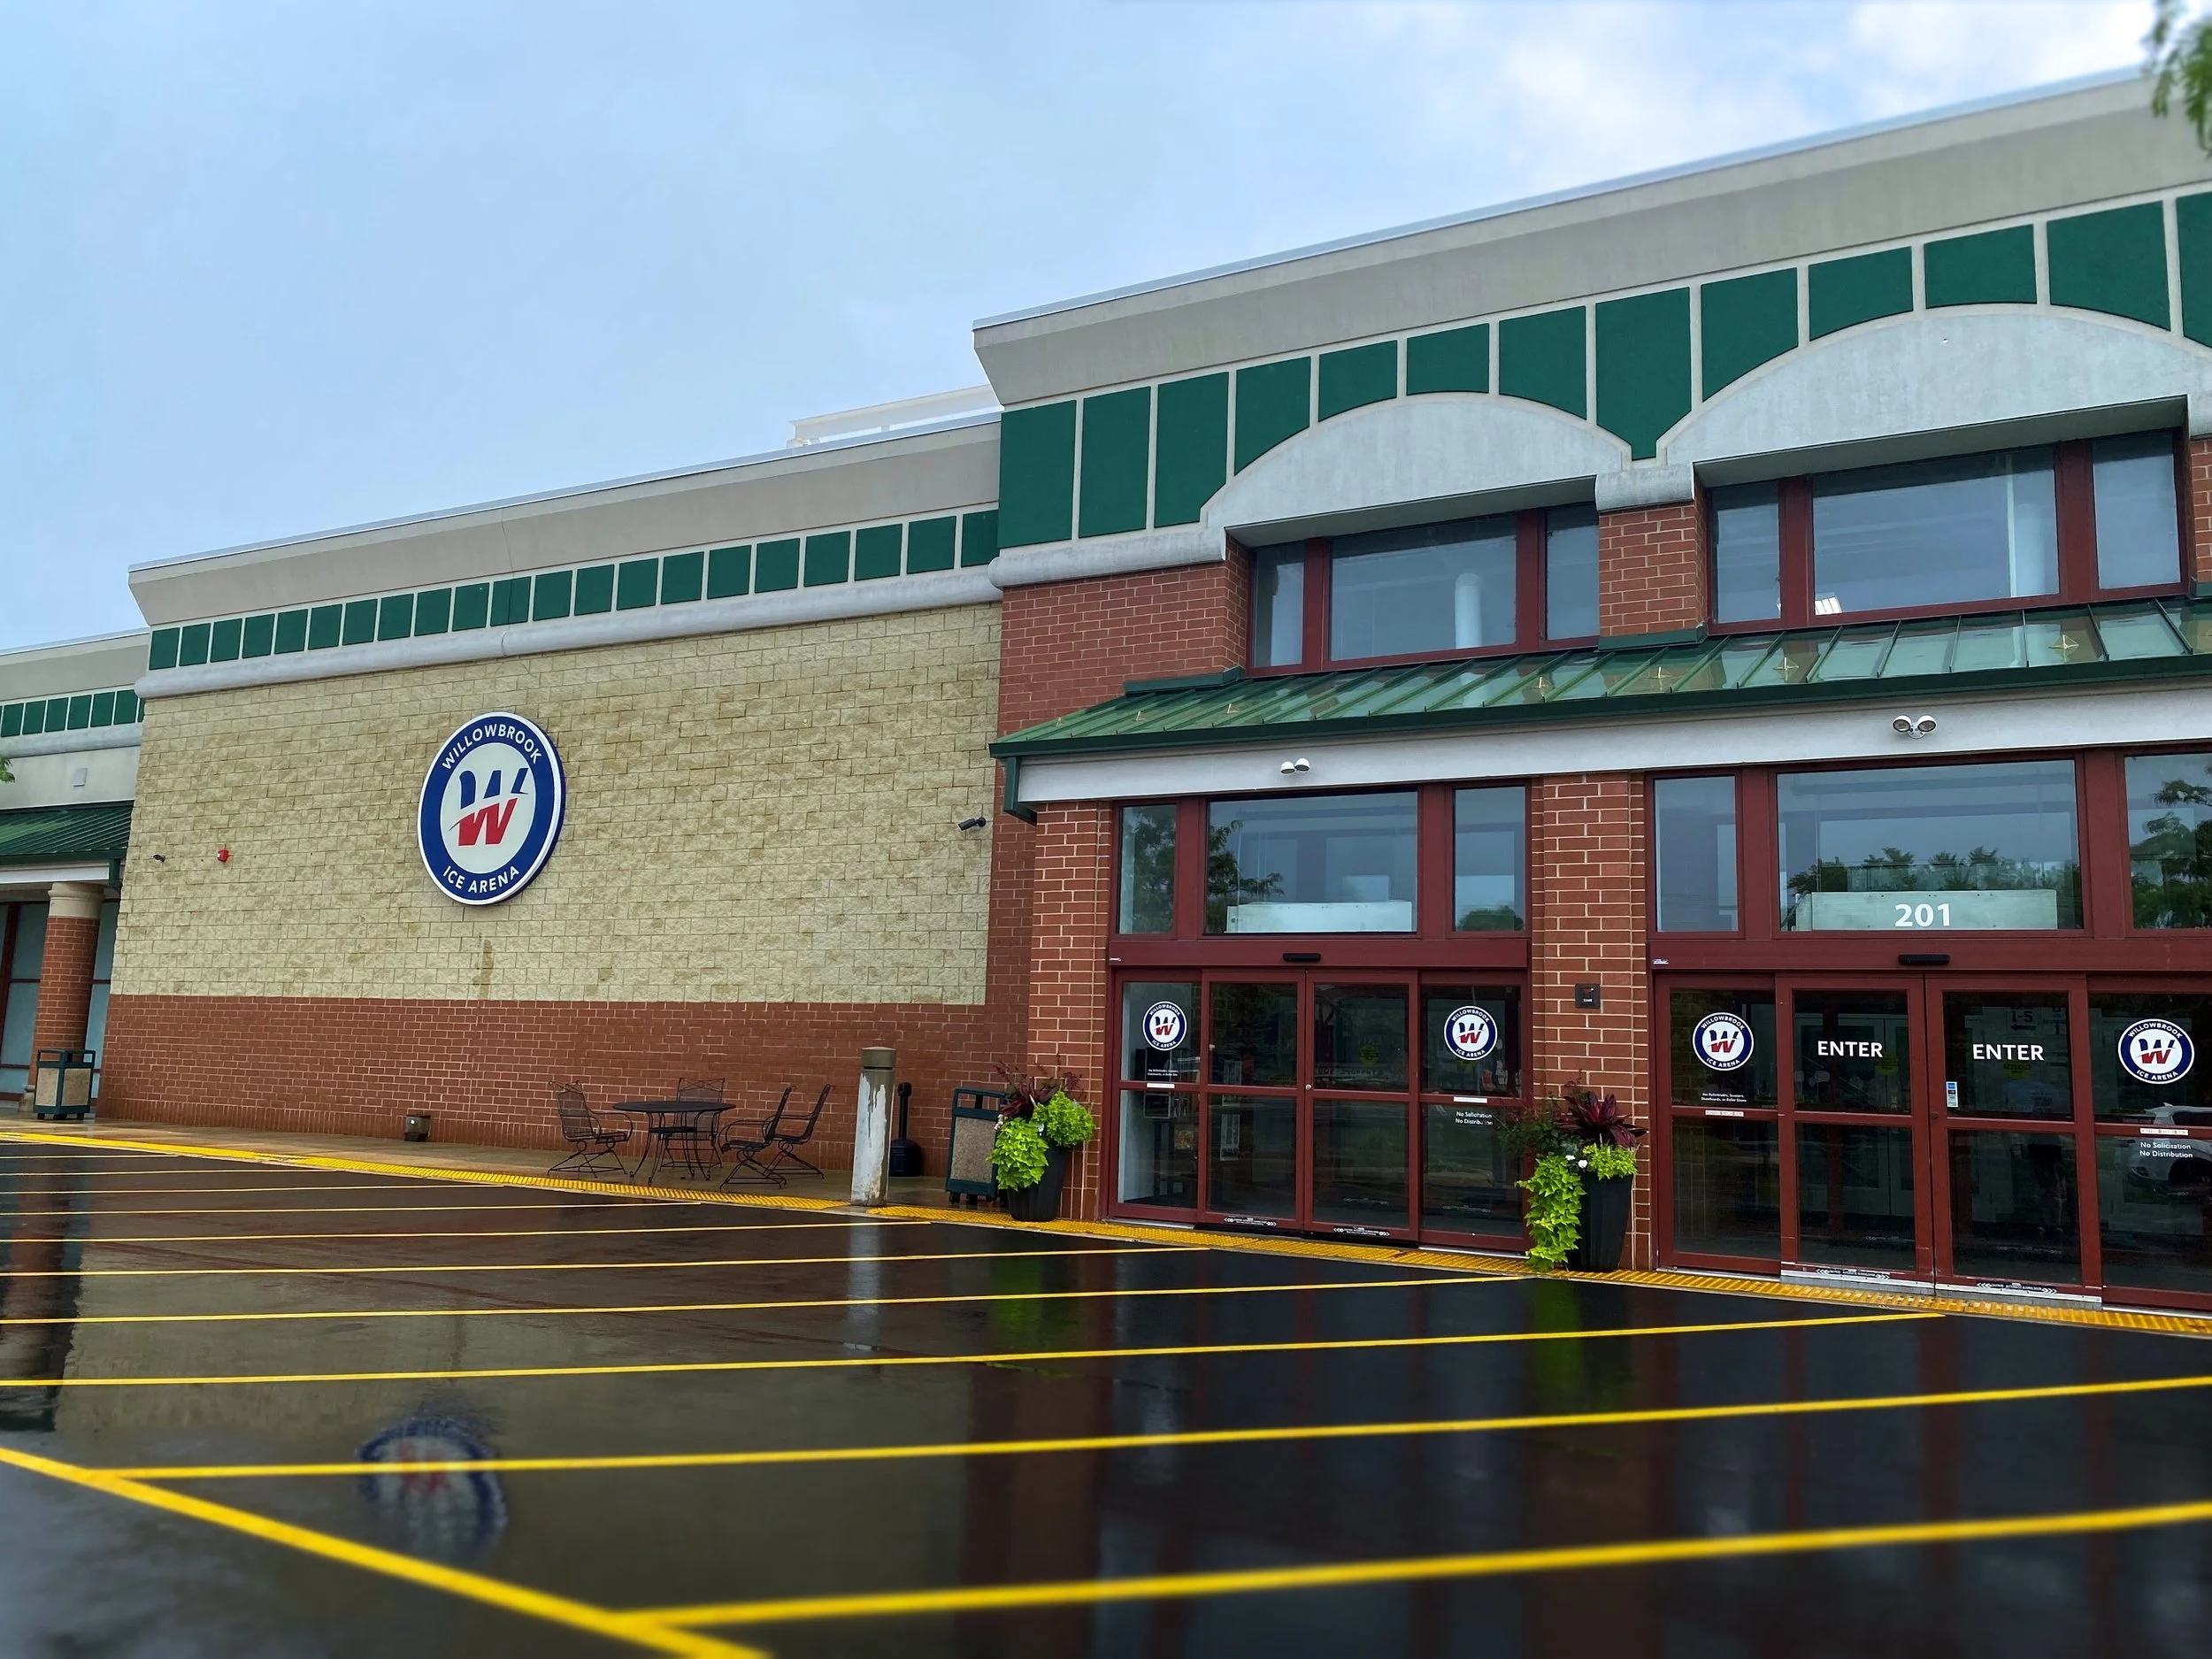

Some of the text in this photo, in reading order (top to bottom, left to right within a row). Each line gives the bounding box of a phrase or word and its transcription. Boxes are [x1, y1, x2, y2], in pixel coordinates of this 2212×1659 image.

[442, 724, 542, 770] WILLOWBROOK
[442, 865, 519, 893] ICE ARENA
[1894, 903, 1950, 927] 201
[1451, 1009, 1490, 1022] WILLOWBROOK
[1701, 1016, 1745, 1031] WILLOWBROOK
[2127, 1022, 2184, 1039] WILLOWBROOK
[1455, 1048, 1465, 1056] ICE
[1817, 1041, 1884, 1057] ENTER
[1972, 1044, 2045, 1061] ENTER
[1707, 1057, 1740, 1068] ICE ARENA
[2136, 1069, 2178, 1081] ICE ARENA
